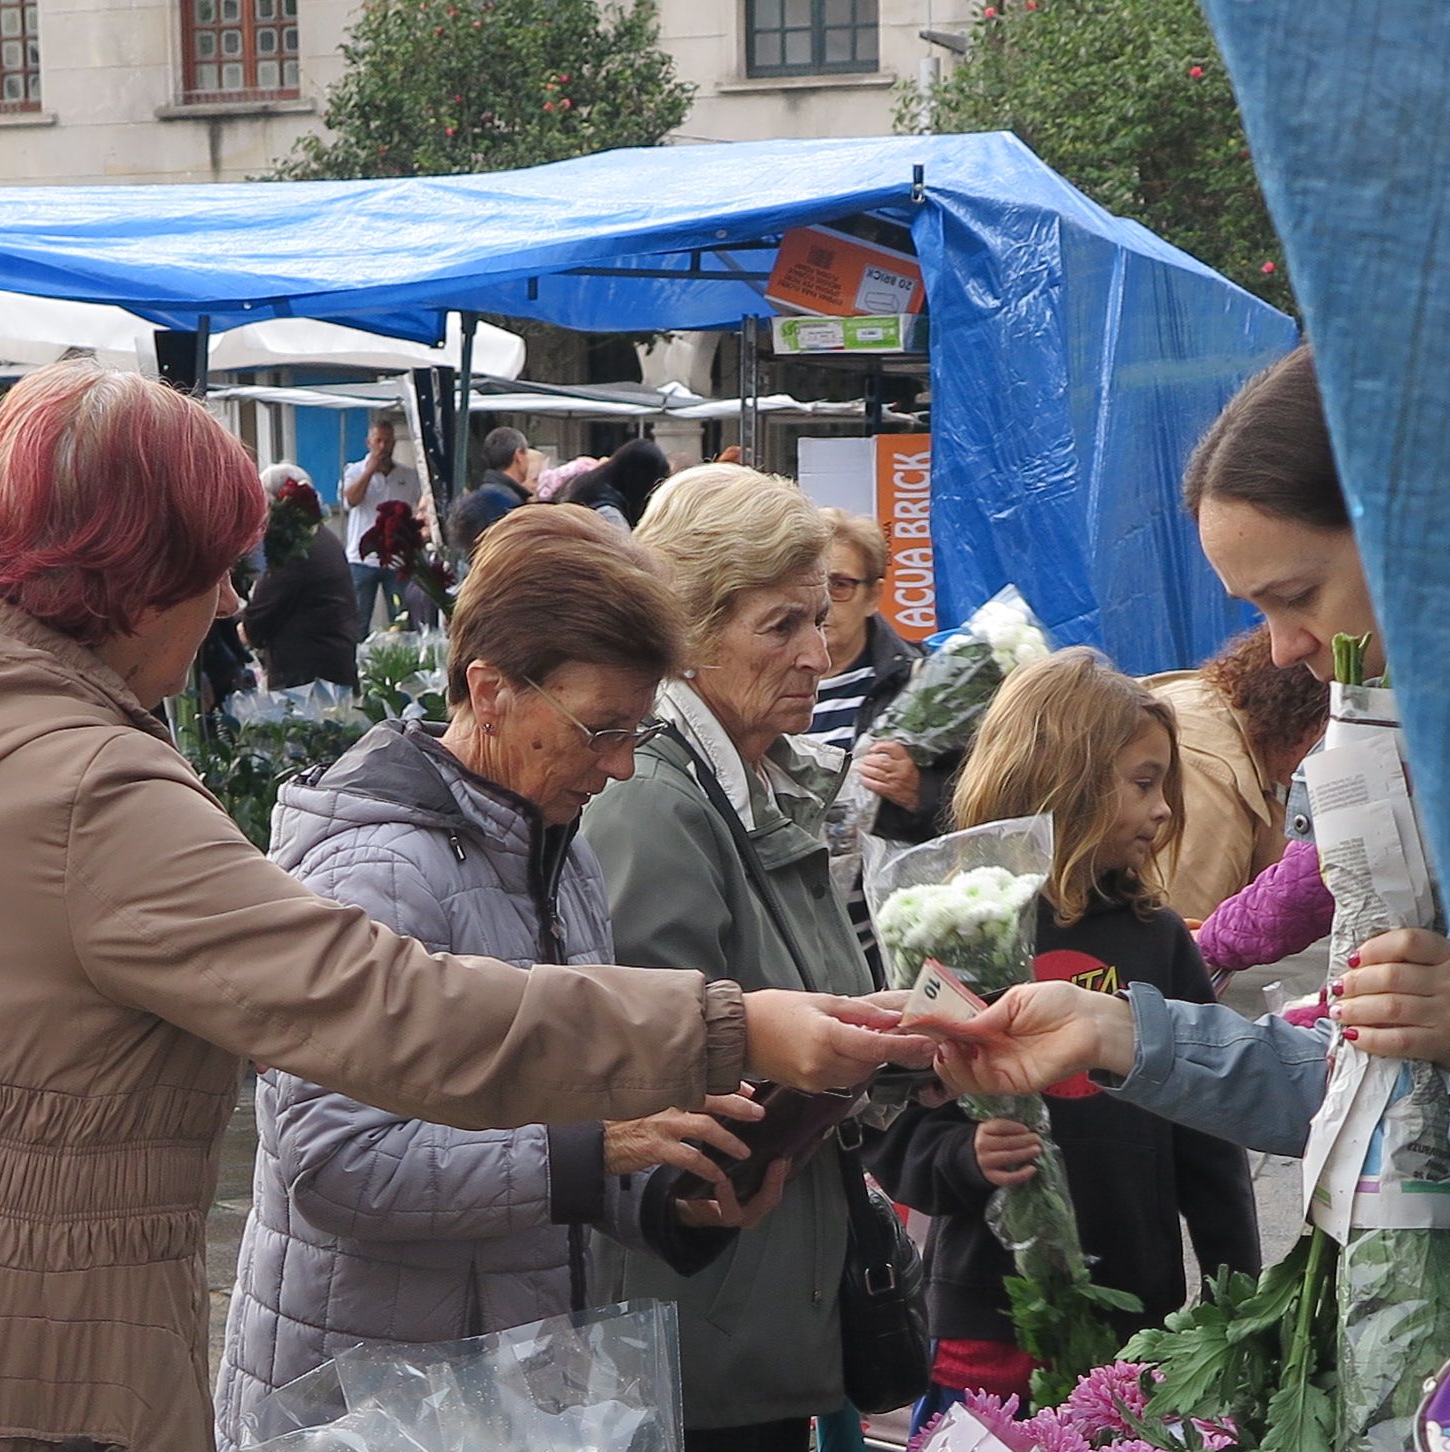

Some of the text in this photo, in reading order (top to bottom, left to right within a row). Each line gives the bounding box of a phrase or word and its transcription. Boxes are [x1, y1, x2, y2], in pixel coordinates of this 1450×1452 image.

[868, 268, 912, 291] 20 BRICK
[893, 451, 936, 627] ACUA BRICK
[924, 978, 941, 1000] 10
